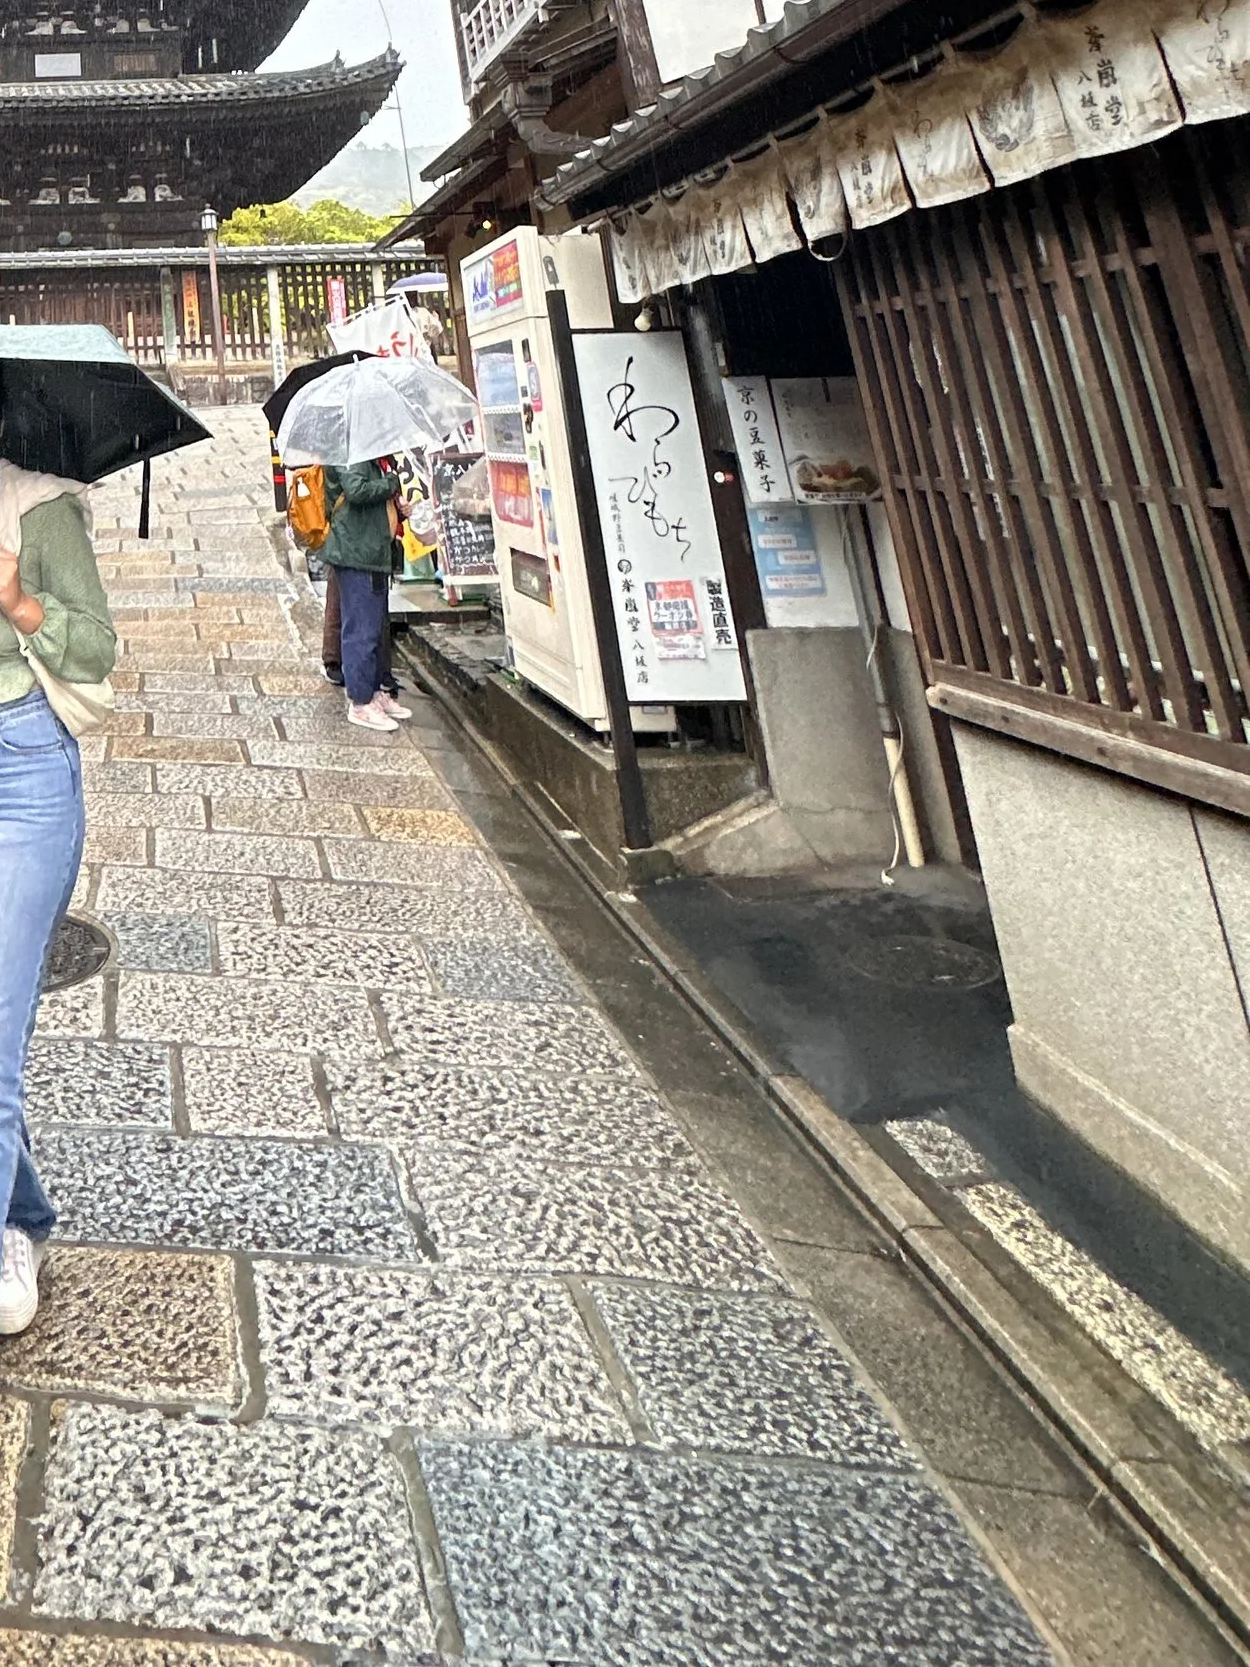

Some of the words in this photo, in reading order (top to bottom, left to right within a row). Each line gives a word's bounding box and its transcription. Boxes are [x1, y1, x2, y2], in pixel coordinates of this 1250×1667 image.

[737, 385, 776, 493] 京の豆菓子
[706, 578, 732, 645] 製造直売
